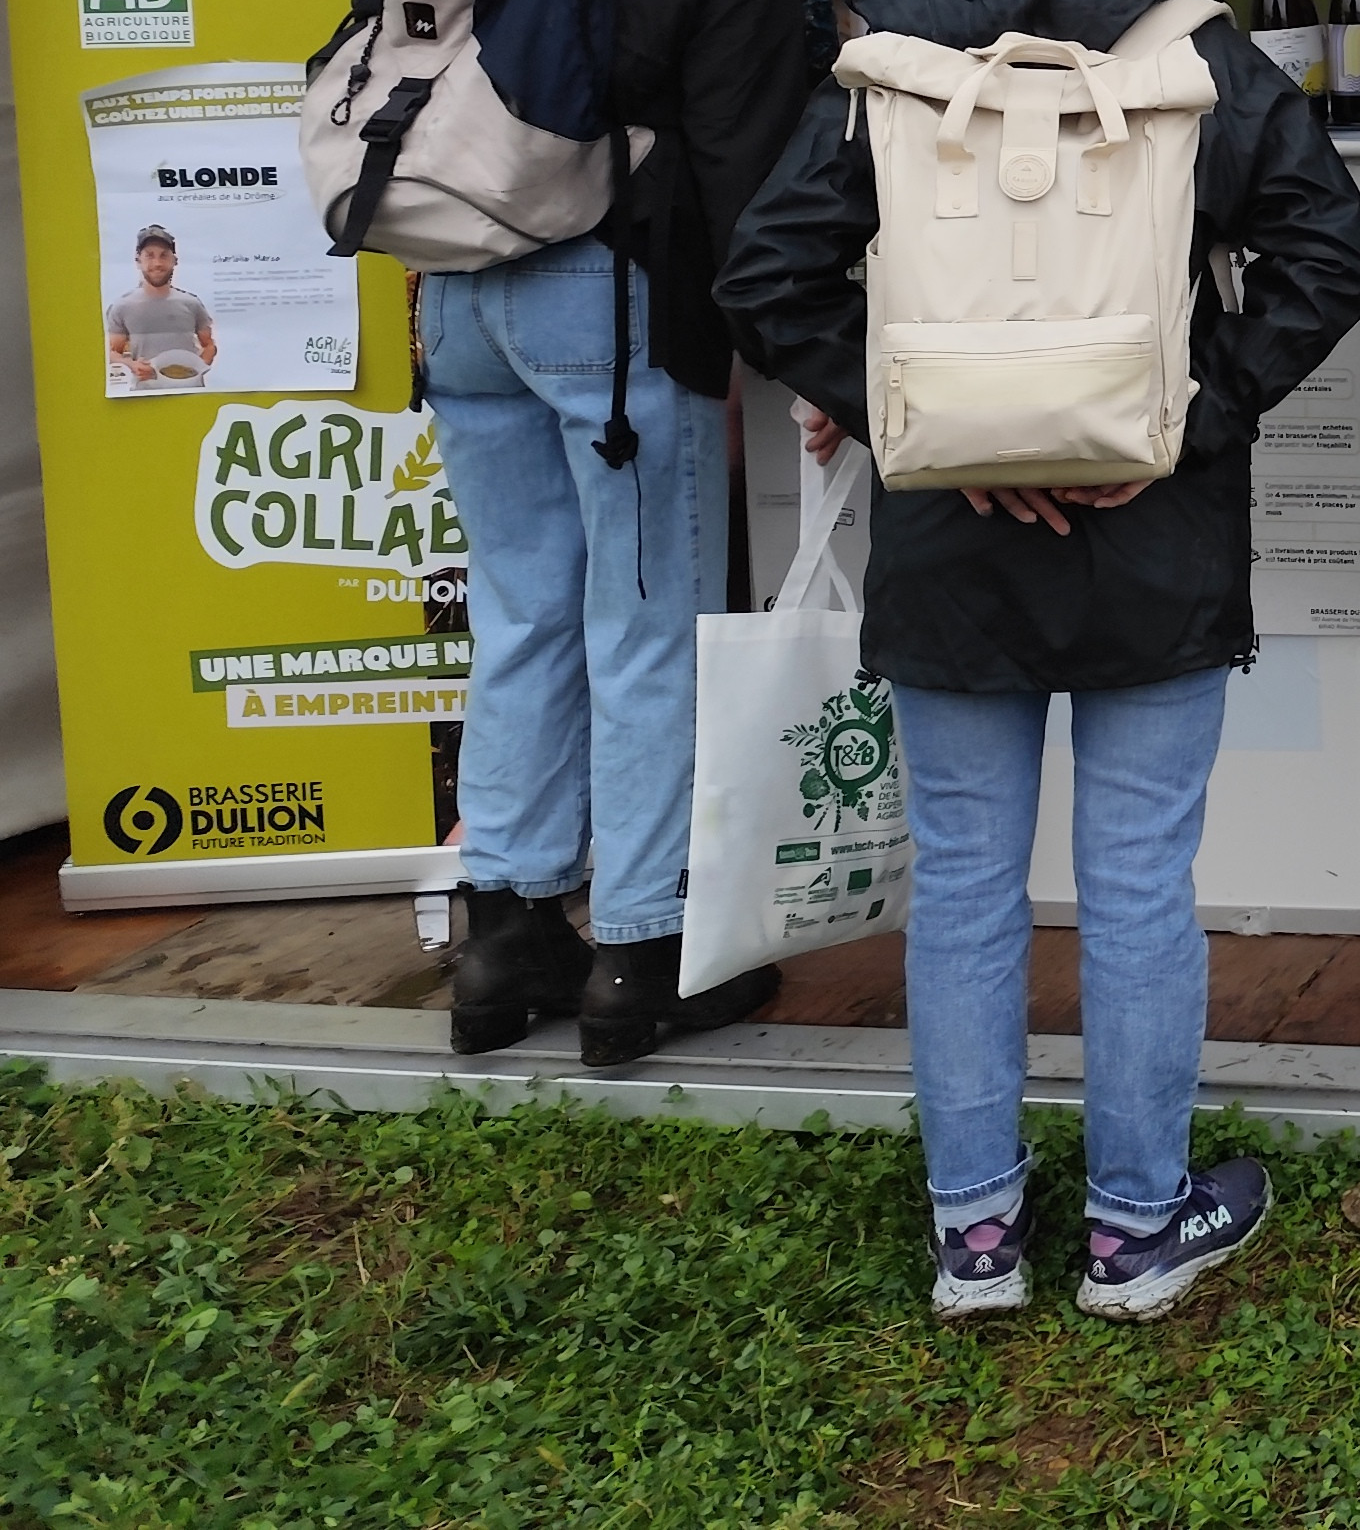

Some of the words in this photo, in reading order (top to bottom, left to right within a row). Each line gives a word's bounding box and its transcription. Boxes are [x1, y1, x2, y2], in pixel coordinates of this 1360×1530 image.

[84, 16, 190, 27] AGRICULTURE
[85, 30, 191, 42] BIOLOGIQUE
[92, 95, 132, 110] AUX
[131, 88, 191, 104] TEMPS
[192, 86, 247, 102] FORTS
[247, 84, 271, 98] DU
[94, 104, 168, 124] GOÛTEZ
[169, 105, 204, 118] UNE
[204, 102, 273, 118] BLONDE
[273, 102, 302, 114] LOC
[157, 165, 279, 188] BLONDE
[305, 336, 338, 351] AGRI
[304, 351, 352, 367] COLLAB
[215, 414, 384, 491] AGRI
[210, 488, 468, 567] COLLAB
[366, 577, 467, 603] DULION
[199, 654, 275, 683] UNE
[280, 642, 438, 678] MARQUE
[242, 689, 267, 718] À
[275, 689, 467, 717] EMPREINT
[188, 781, 324, 807] BRASSERIE
[191, 803, 325, 836] DULION
[192, 836, 245, 850] FUTURE
[249, 832, 326, 848] TRADITION
[1179, 1204, 1233, 1244] HOKA
